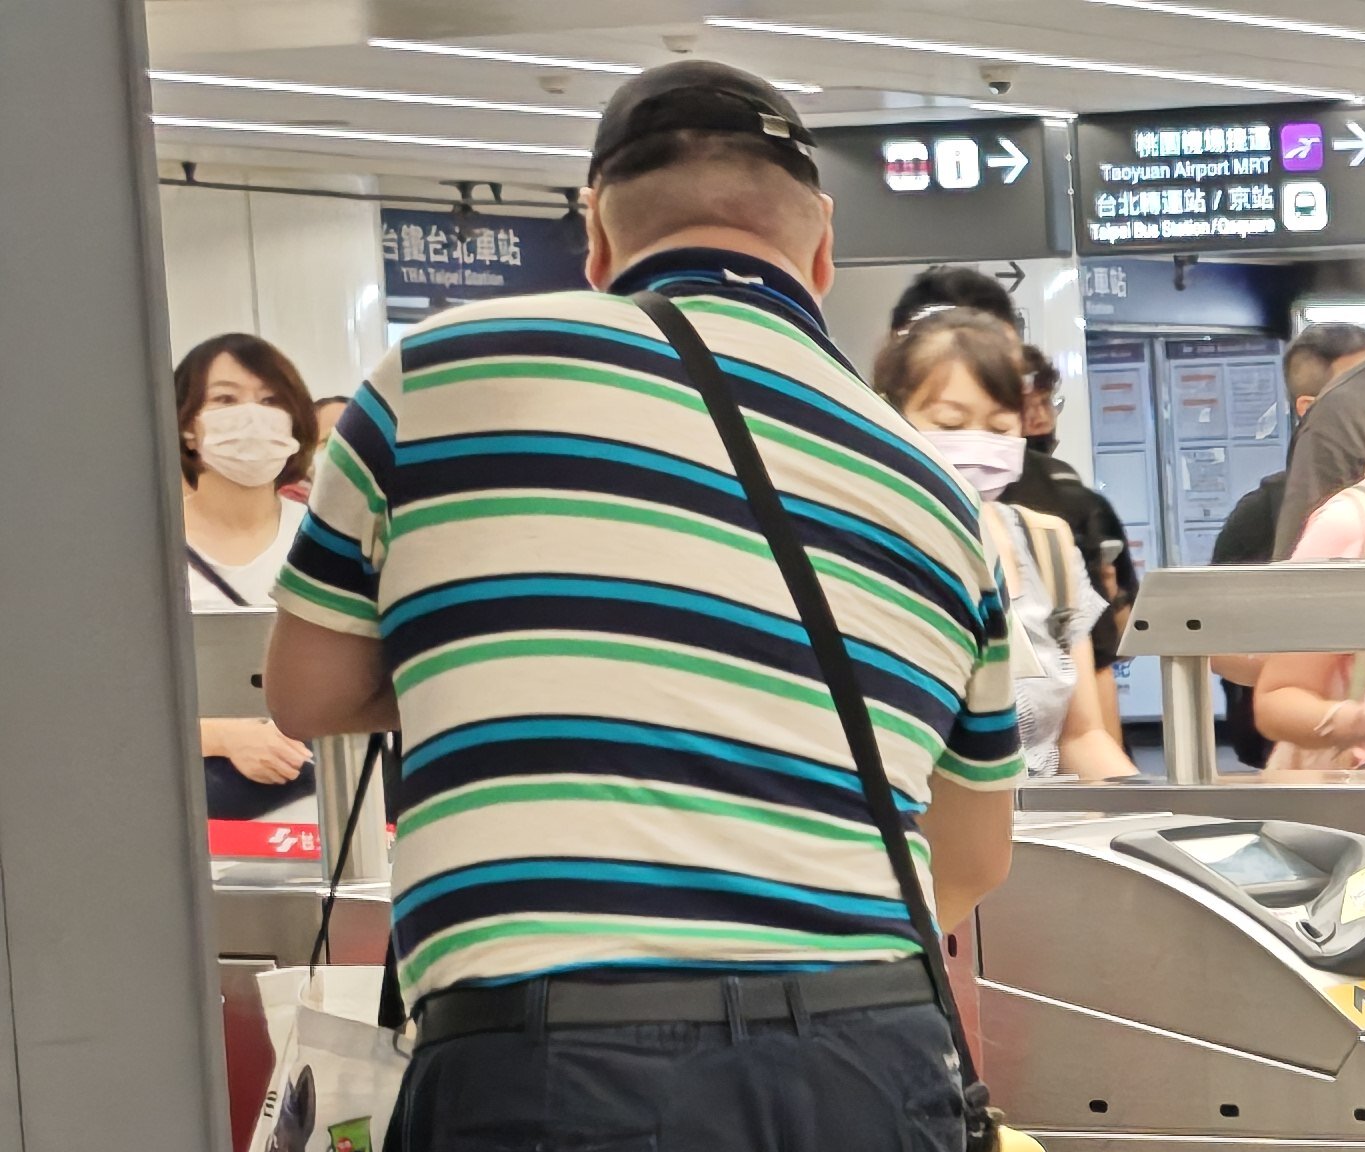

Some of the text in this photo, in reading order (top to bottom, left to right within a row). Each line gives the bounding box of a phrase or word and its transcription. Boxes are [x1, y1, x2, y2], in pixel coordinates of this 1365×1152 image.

[1100, 156, 1272, 185] Taoyuan Airport MRT
